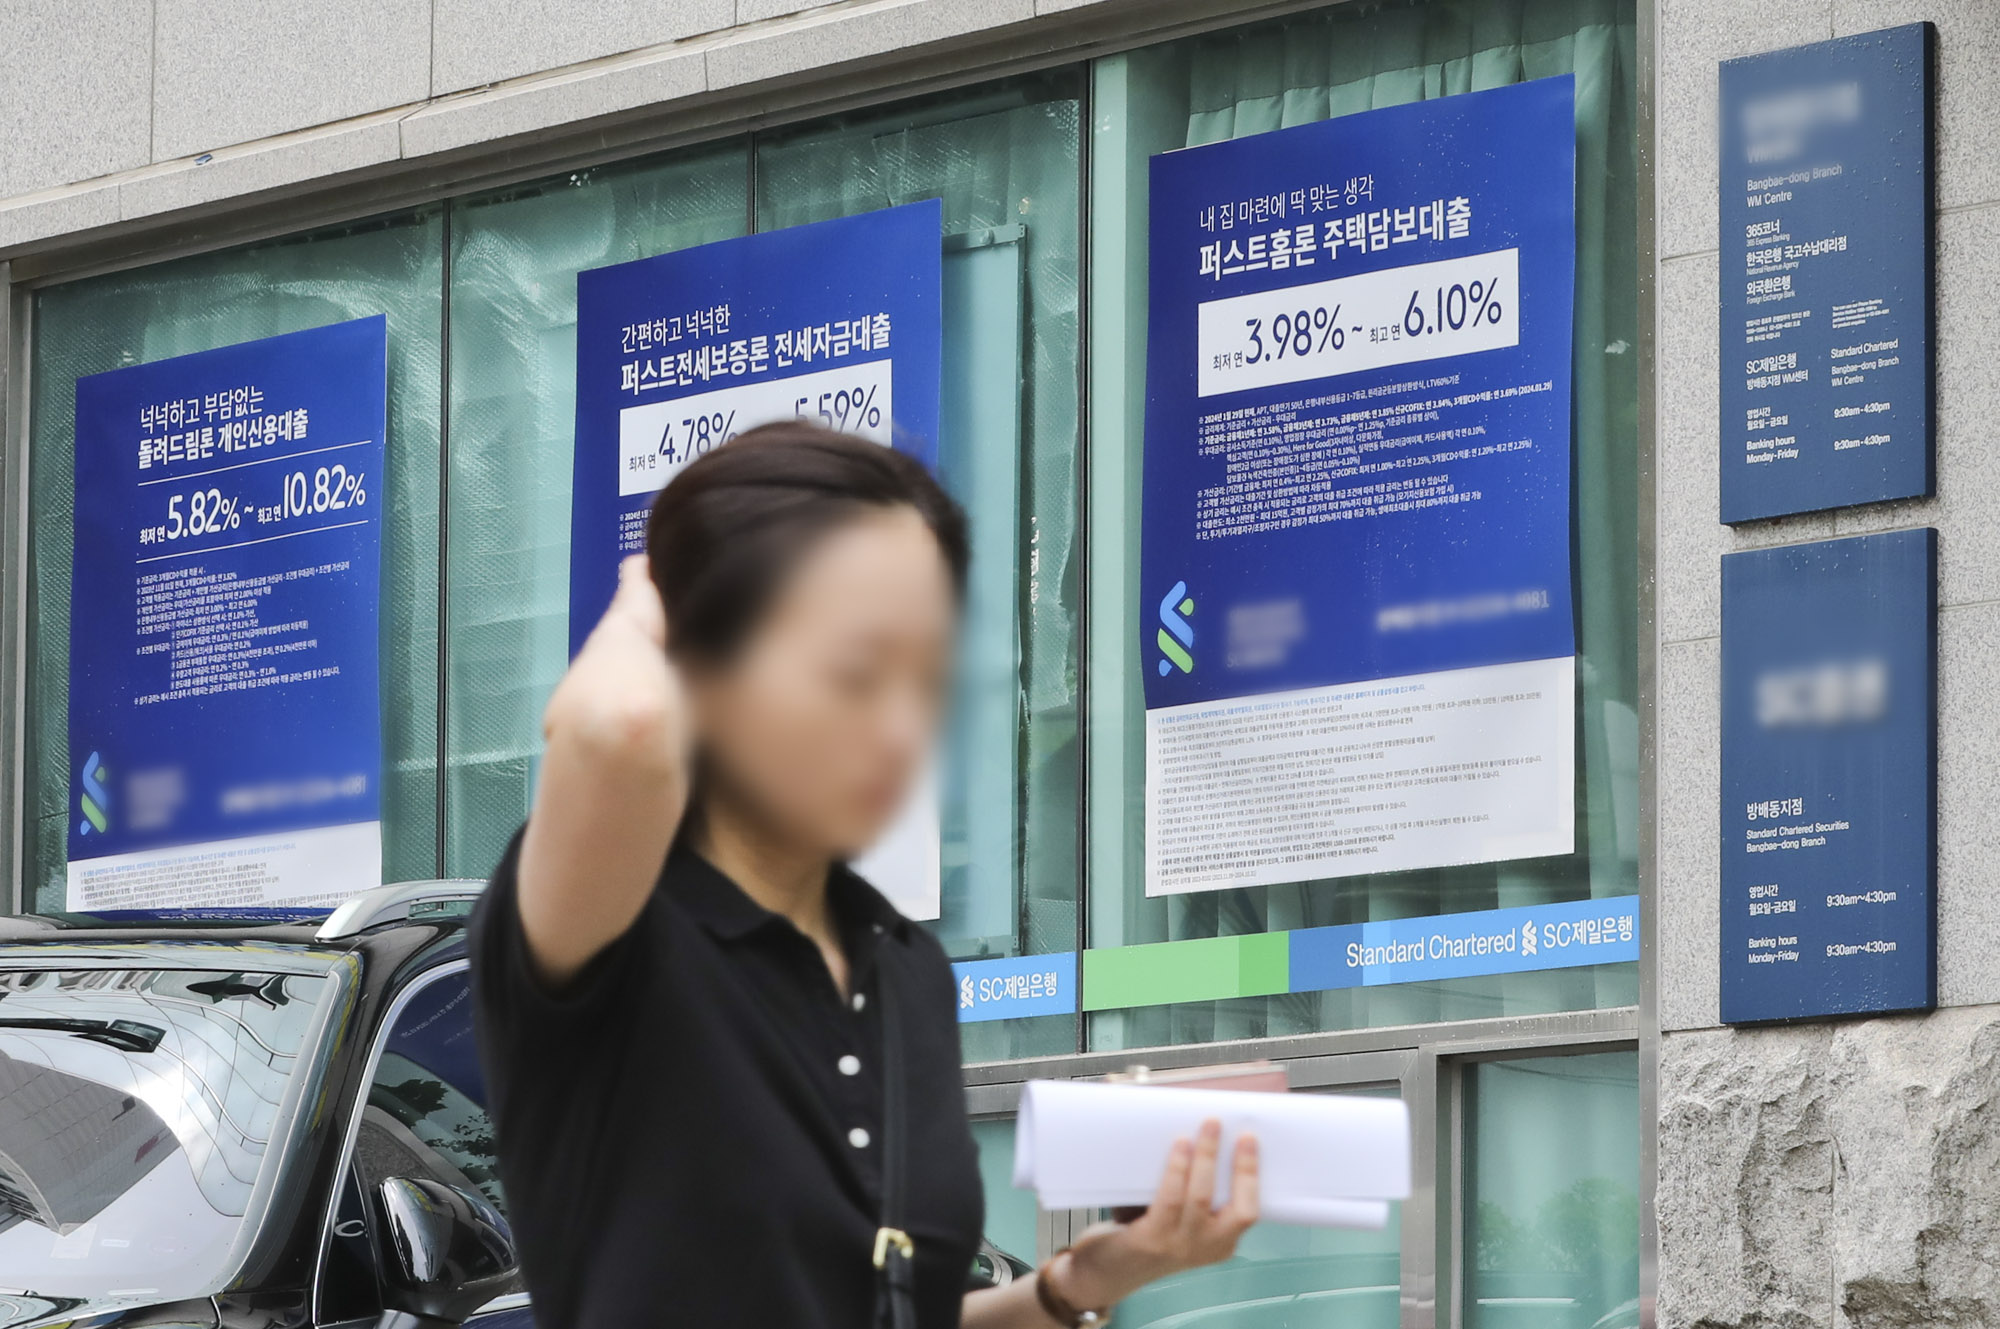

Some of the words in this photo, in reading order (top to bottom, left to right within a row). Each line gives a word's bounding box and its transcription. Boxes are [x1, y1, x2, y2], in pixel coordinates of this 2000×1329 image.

[1747, 172, 1809, 191] Bangbae-dong
[1812, 163, 1842, 179] Branch
[1200, 205, 1214, 232] 내
[1220, 202, 1233, 229] 집
[1239, 192, 1285, 224] 마련에
[1291, 188, 1305, 214] 딱
[1310, 184, 1339, 212] 맞는
[1343, 174, 1373, 205] 생각
[1747, 194, 1761, 207] WM
[1763, 191, 1792, 204] Centre
[1199, 224, 1316, 280] 퍼스트홈론
[1323, 196, 1470, 259] 주택담보대출
[1746, 219, 1779, 237] 365코너
[1746, 247, 1781, 266] 한국은행
[1784, 235, 1846, 259] 국고수납대리점
[1746, 275, 1790, 295] 외국환은행
[622, 317, 682, 353] 간편하고
[686, 304, 730, 339] 넉넉한
[1213, 352, 1230, 370] 최저
[1233, 350, 1242, 367] 연
[1246, 304, 1344, 364] 3.98%
[1370, 326, 1387, 343] 최고
[1391, 323, 1400, 340] 연
[1404, 277, 1501, 336] 6.10%
[621, 335, 769, 395] 퍼스트전세보증론
[774, 312, 890, 367] 전세자금대출
[1831, 344, 1862, 358] Standard
[1863, 338, 1898, 353] Chartered
[1746, 352, 1796, 374] SC제일은행
[1831, 361, 1876, 374] Bangbae-dong
[1878, 356, 1898, 367] Branch
[1746, 374, 1780, 390] 방배동지점
[1782, 369, 1808, 383] WM센터
[1831, 377, 1842, 386] WM
[1844, 375, 1863, 384] Centre
[141, 399, 199, 434] 넉넉하고
[204, 386, 263, 422] 부담없는
[1746, 406, 1770, 419] 영업시간
[138, 427, 214, 469] 돌려드림론
[218, 408, 308, 452] 개인신용대출
[1746, 438, 1774, 450] Banking
[1775, 436, 1795, 446] hours
[628, 456, 646, 472] 최저
[647, 453, 656, 470] 연
[140, 527, 155, 544] 최저
[156, 525, 164, 542] 연
[167, 488, 239, 539] 5.82%
[258, 507, 271, 524] 최고
[271, 504, 281, 521] 연
[284, 464, 365, 518] 10.82%
[1747, 797, 1802, 820] 방배동지점
[1746, 827, 1777, 839] Standard
[1779, 823, 1813, 836] Chartered
[1815, 820, 1849, 832] Securities
[1746, 840, 1799, 852] Bangbae-dong
[1801, 836, 1825, 846] Branch
[1749, 884, 1778, 898] 영업시간
[1826, 890, 1896, 906] 9:30am~4:30pm
[1346, 936, 1425, 968] Standard
[1428, 928, 1516, 960] Chartered
[1543, 915, 1633, 948] SC제일은행
[1748, 937, 1776, 948] Banking
[1778, 936, 1797, 945] hours
[1826, 940, 1896, 956] 9:30am~4:30pm
[979, 972, 1056, 1002] SC제일은행
